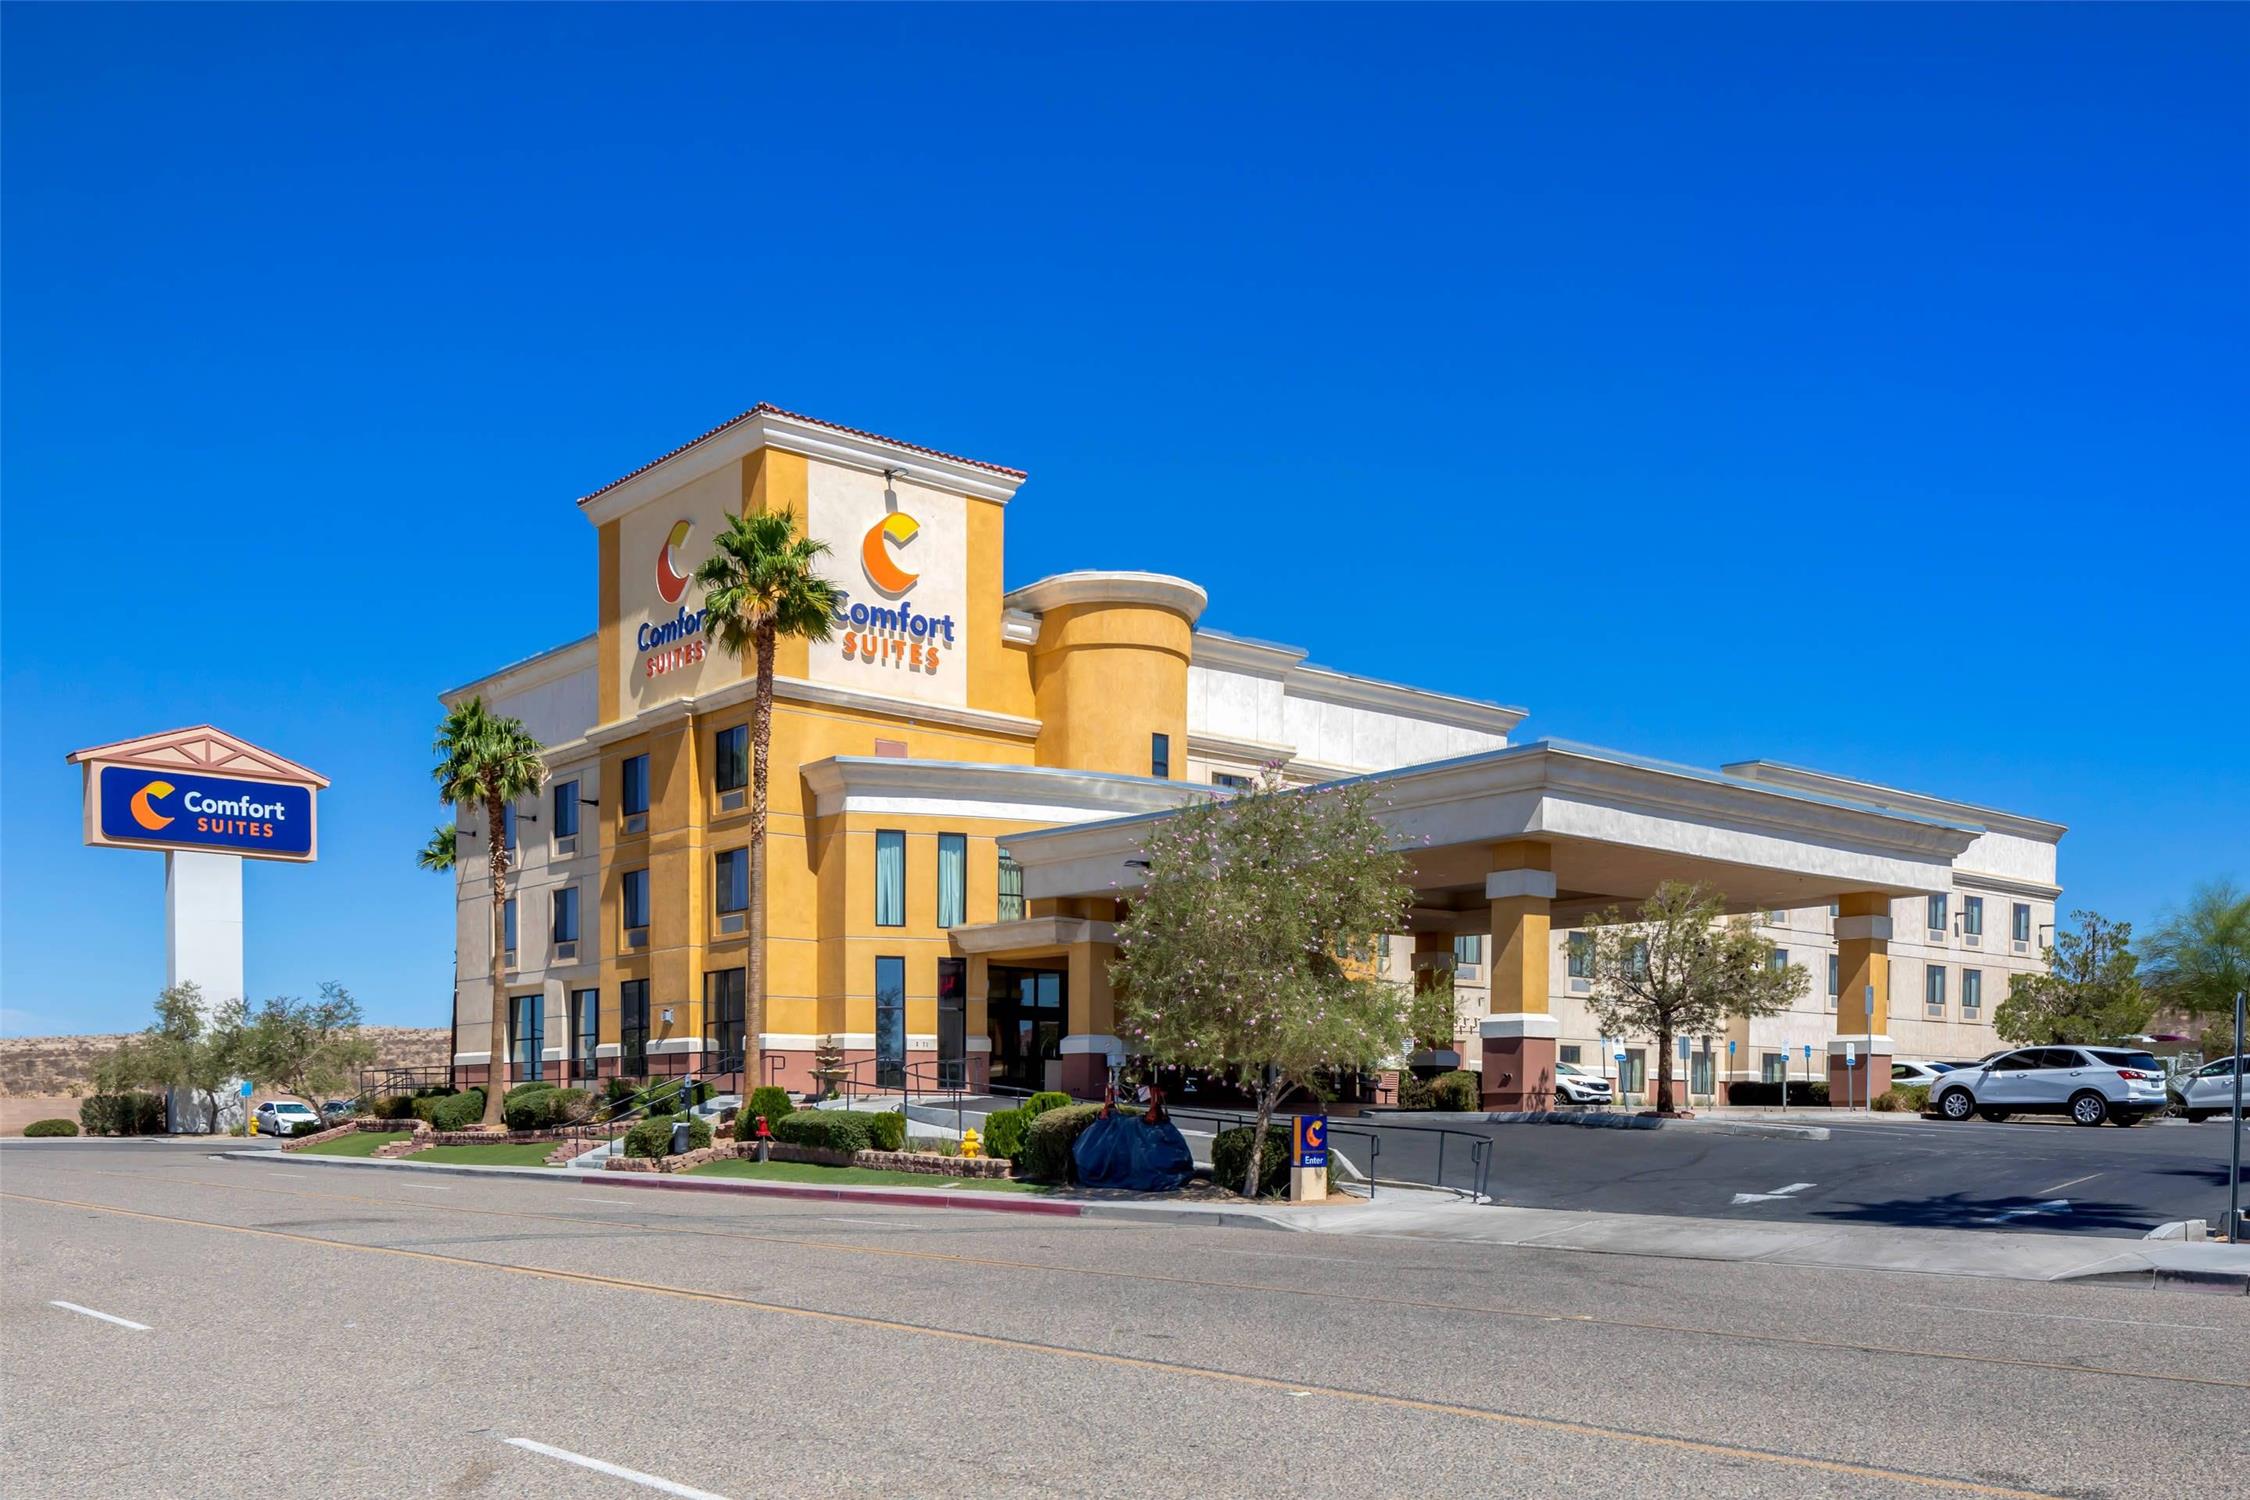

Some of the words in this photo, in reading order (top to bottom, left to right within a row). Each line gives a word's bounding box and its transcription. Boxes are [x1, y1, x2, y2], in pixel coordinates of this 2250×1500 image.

[638, 606, 708, 651] Comfor
[646, 640, 704, 678] SUITES
[844, 632, 939, 669] SUITES
[184, 791, 285, 820] Comfort
[198, 818, 273, 838] SUITES
[1305, 1155, 1323, 1165] Enter
